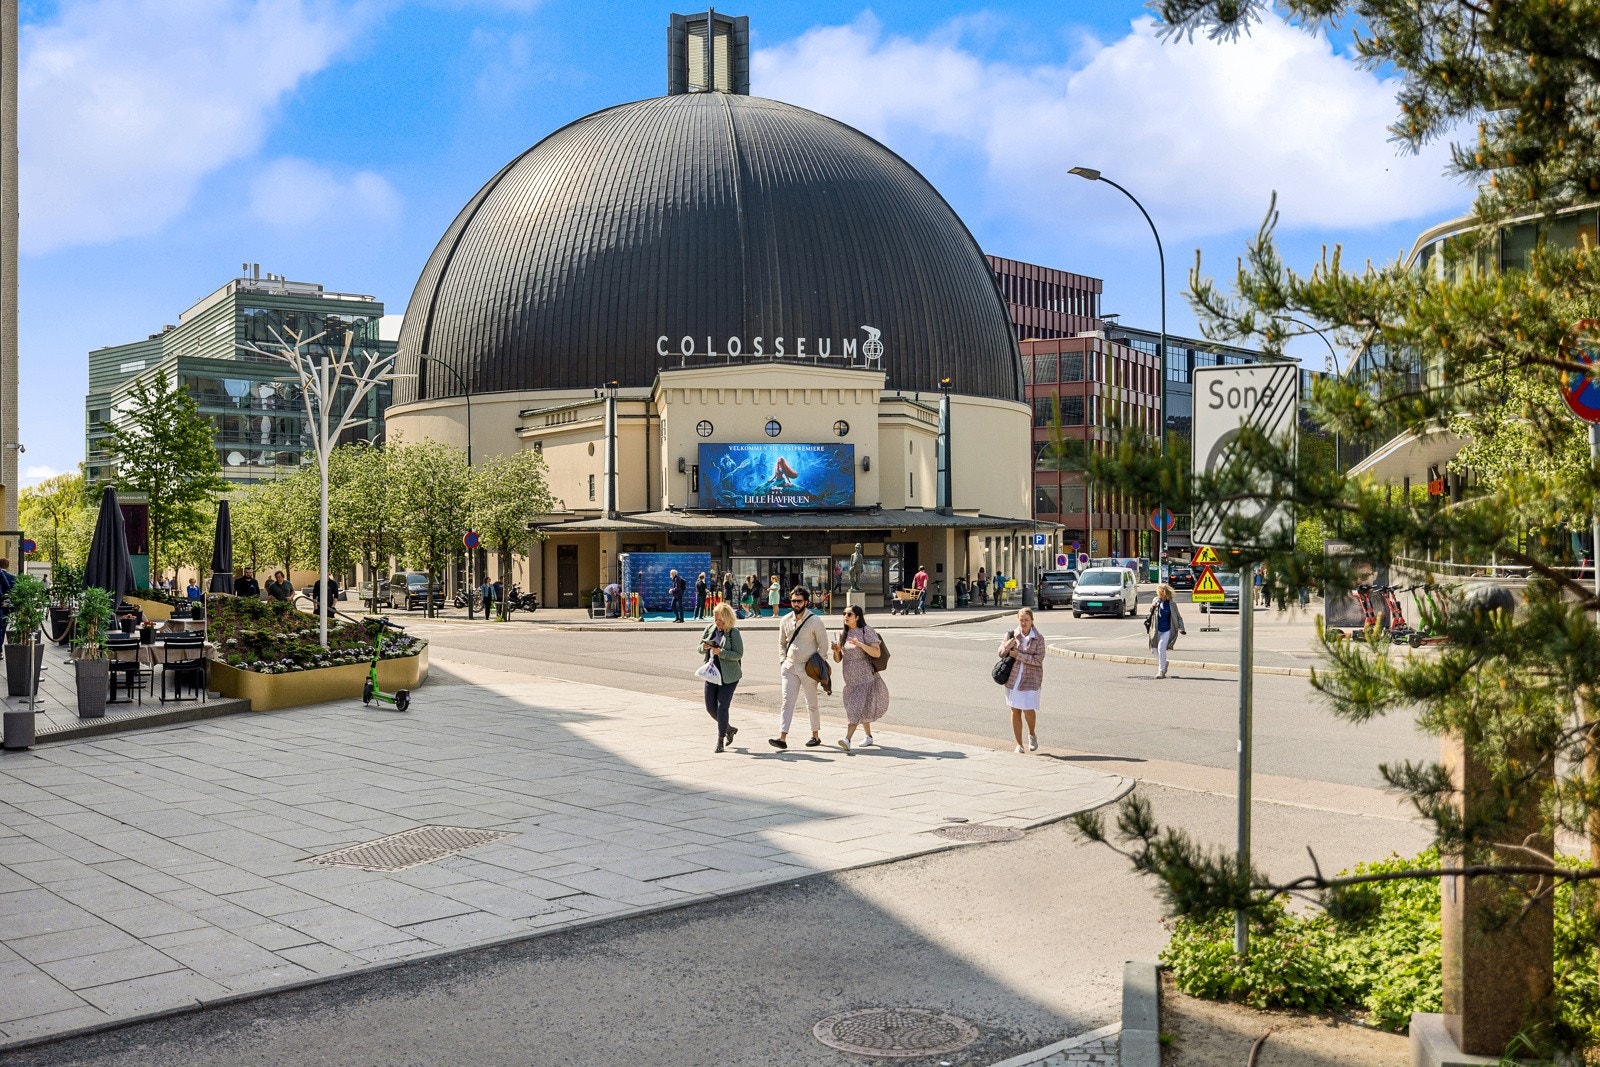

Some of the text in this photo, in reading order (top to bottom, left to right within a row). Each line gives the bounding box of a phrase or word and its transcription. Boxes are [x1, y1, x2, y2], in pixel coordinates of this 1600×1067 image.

[656, 335, 857, 359] COLOSSEUM
[1208, 379, 1275, 410] Sone
[744, 495, 810, 506] LILLE HAVFRUEN
[1036, 535, 1043, 544] P
